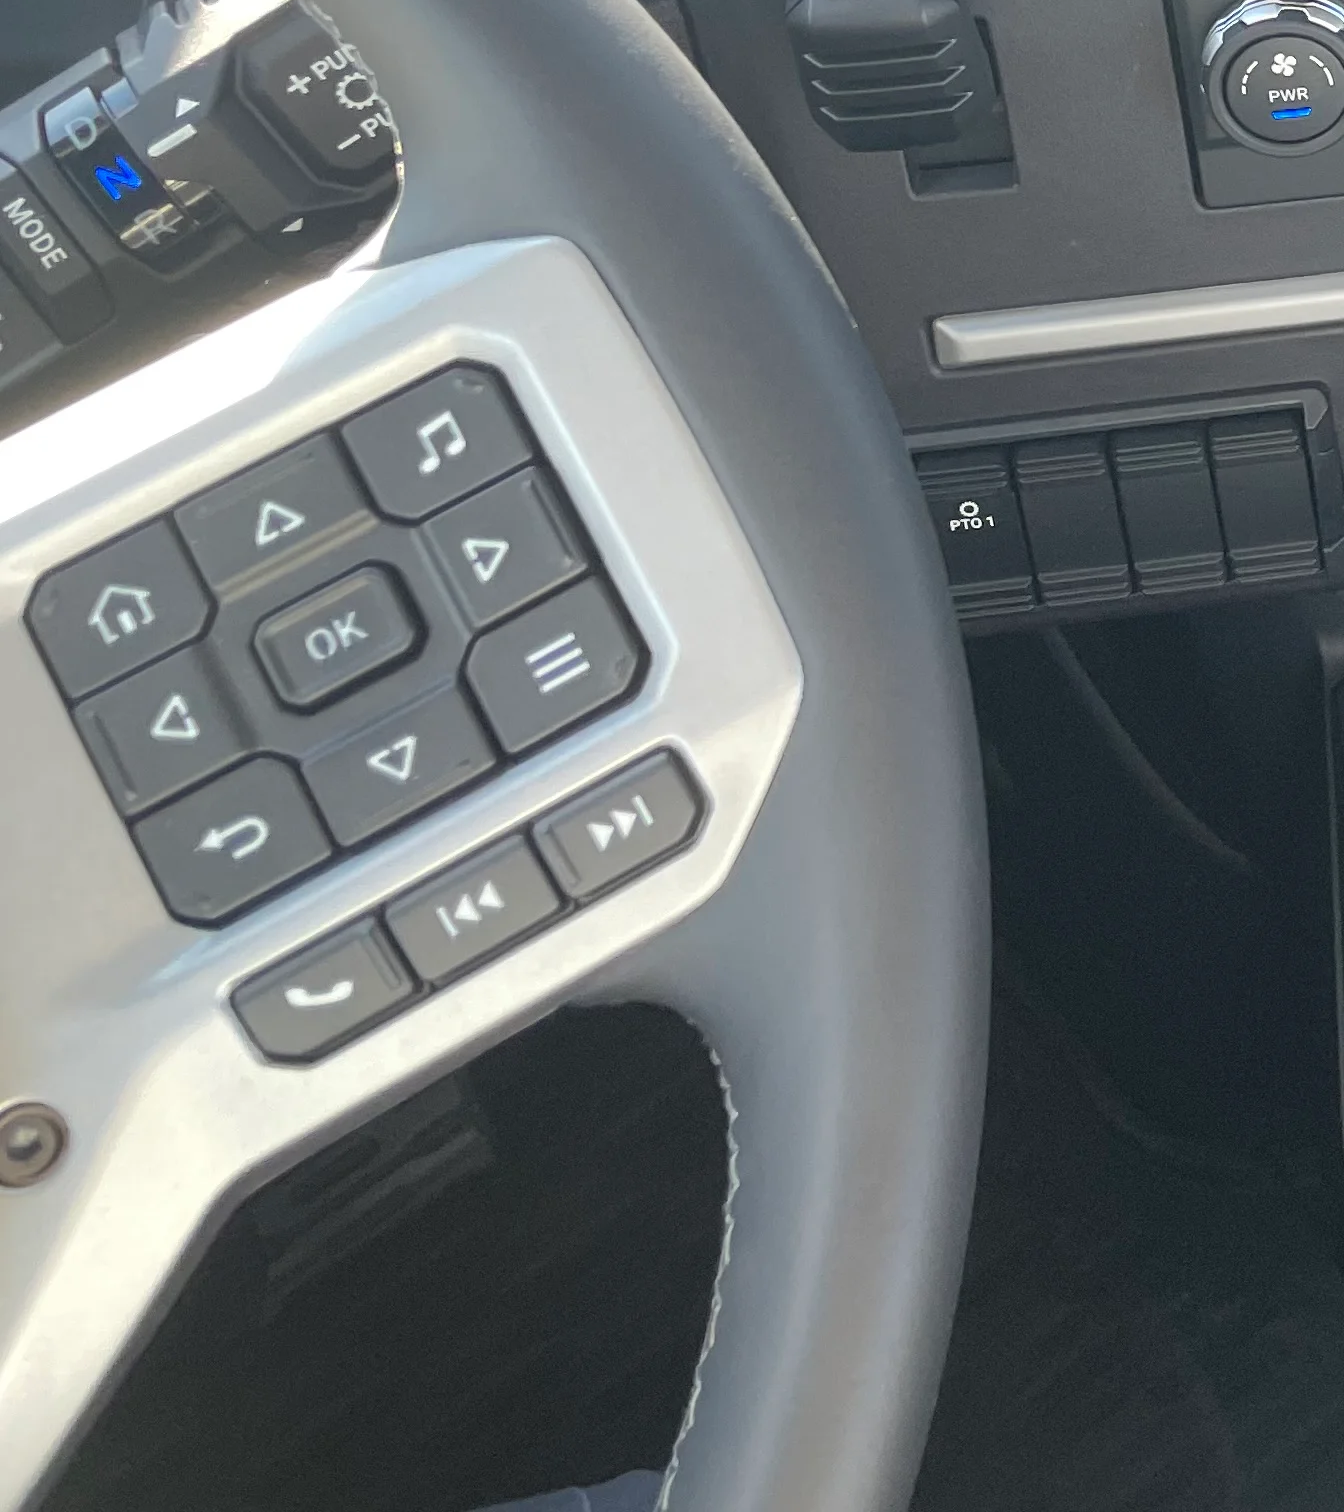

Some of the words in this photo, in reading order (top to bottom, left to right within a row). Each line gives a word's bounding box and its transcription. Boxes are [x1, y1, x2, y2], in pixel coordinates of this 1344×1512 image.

[1268, 87, 1309, 103] PWR
[64, 116, 97, 150] D
[94, 155, 142, 201] N
[2, 197, 68, 271] MODE
[949, 517, 983, 532] PTO
[985, 515, 995, 527] 1
[304, 610, 370, 660] OK
